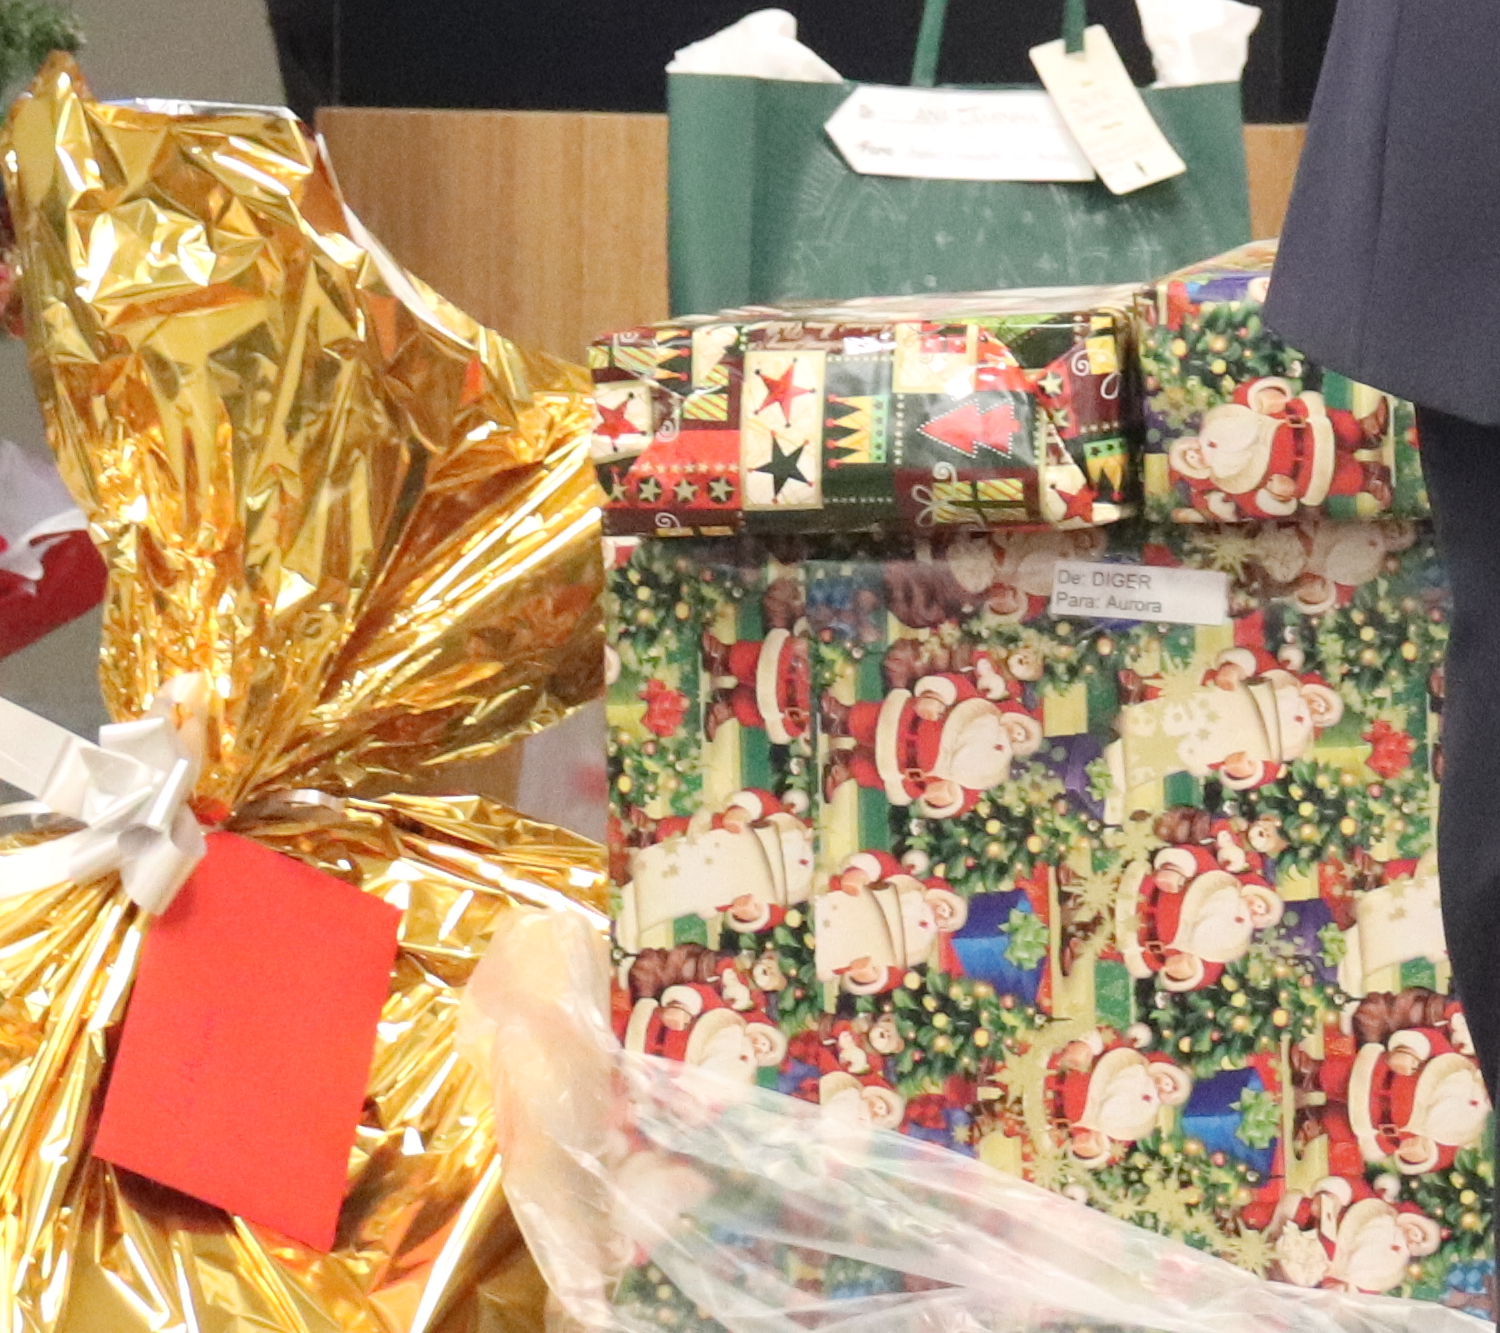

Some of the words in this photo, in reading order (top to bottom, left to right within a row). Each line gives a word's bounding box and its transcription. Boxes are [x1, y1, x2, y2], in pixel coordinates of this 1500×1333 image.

[1092, 571, 1152, 590] DIGER
[1056, 591, 1100, 609] Para:
[1105, 595, 1162, 613] Aurora
